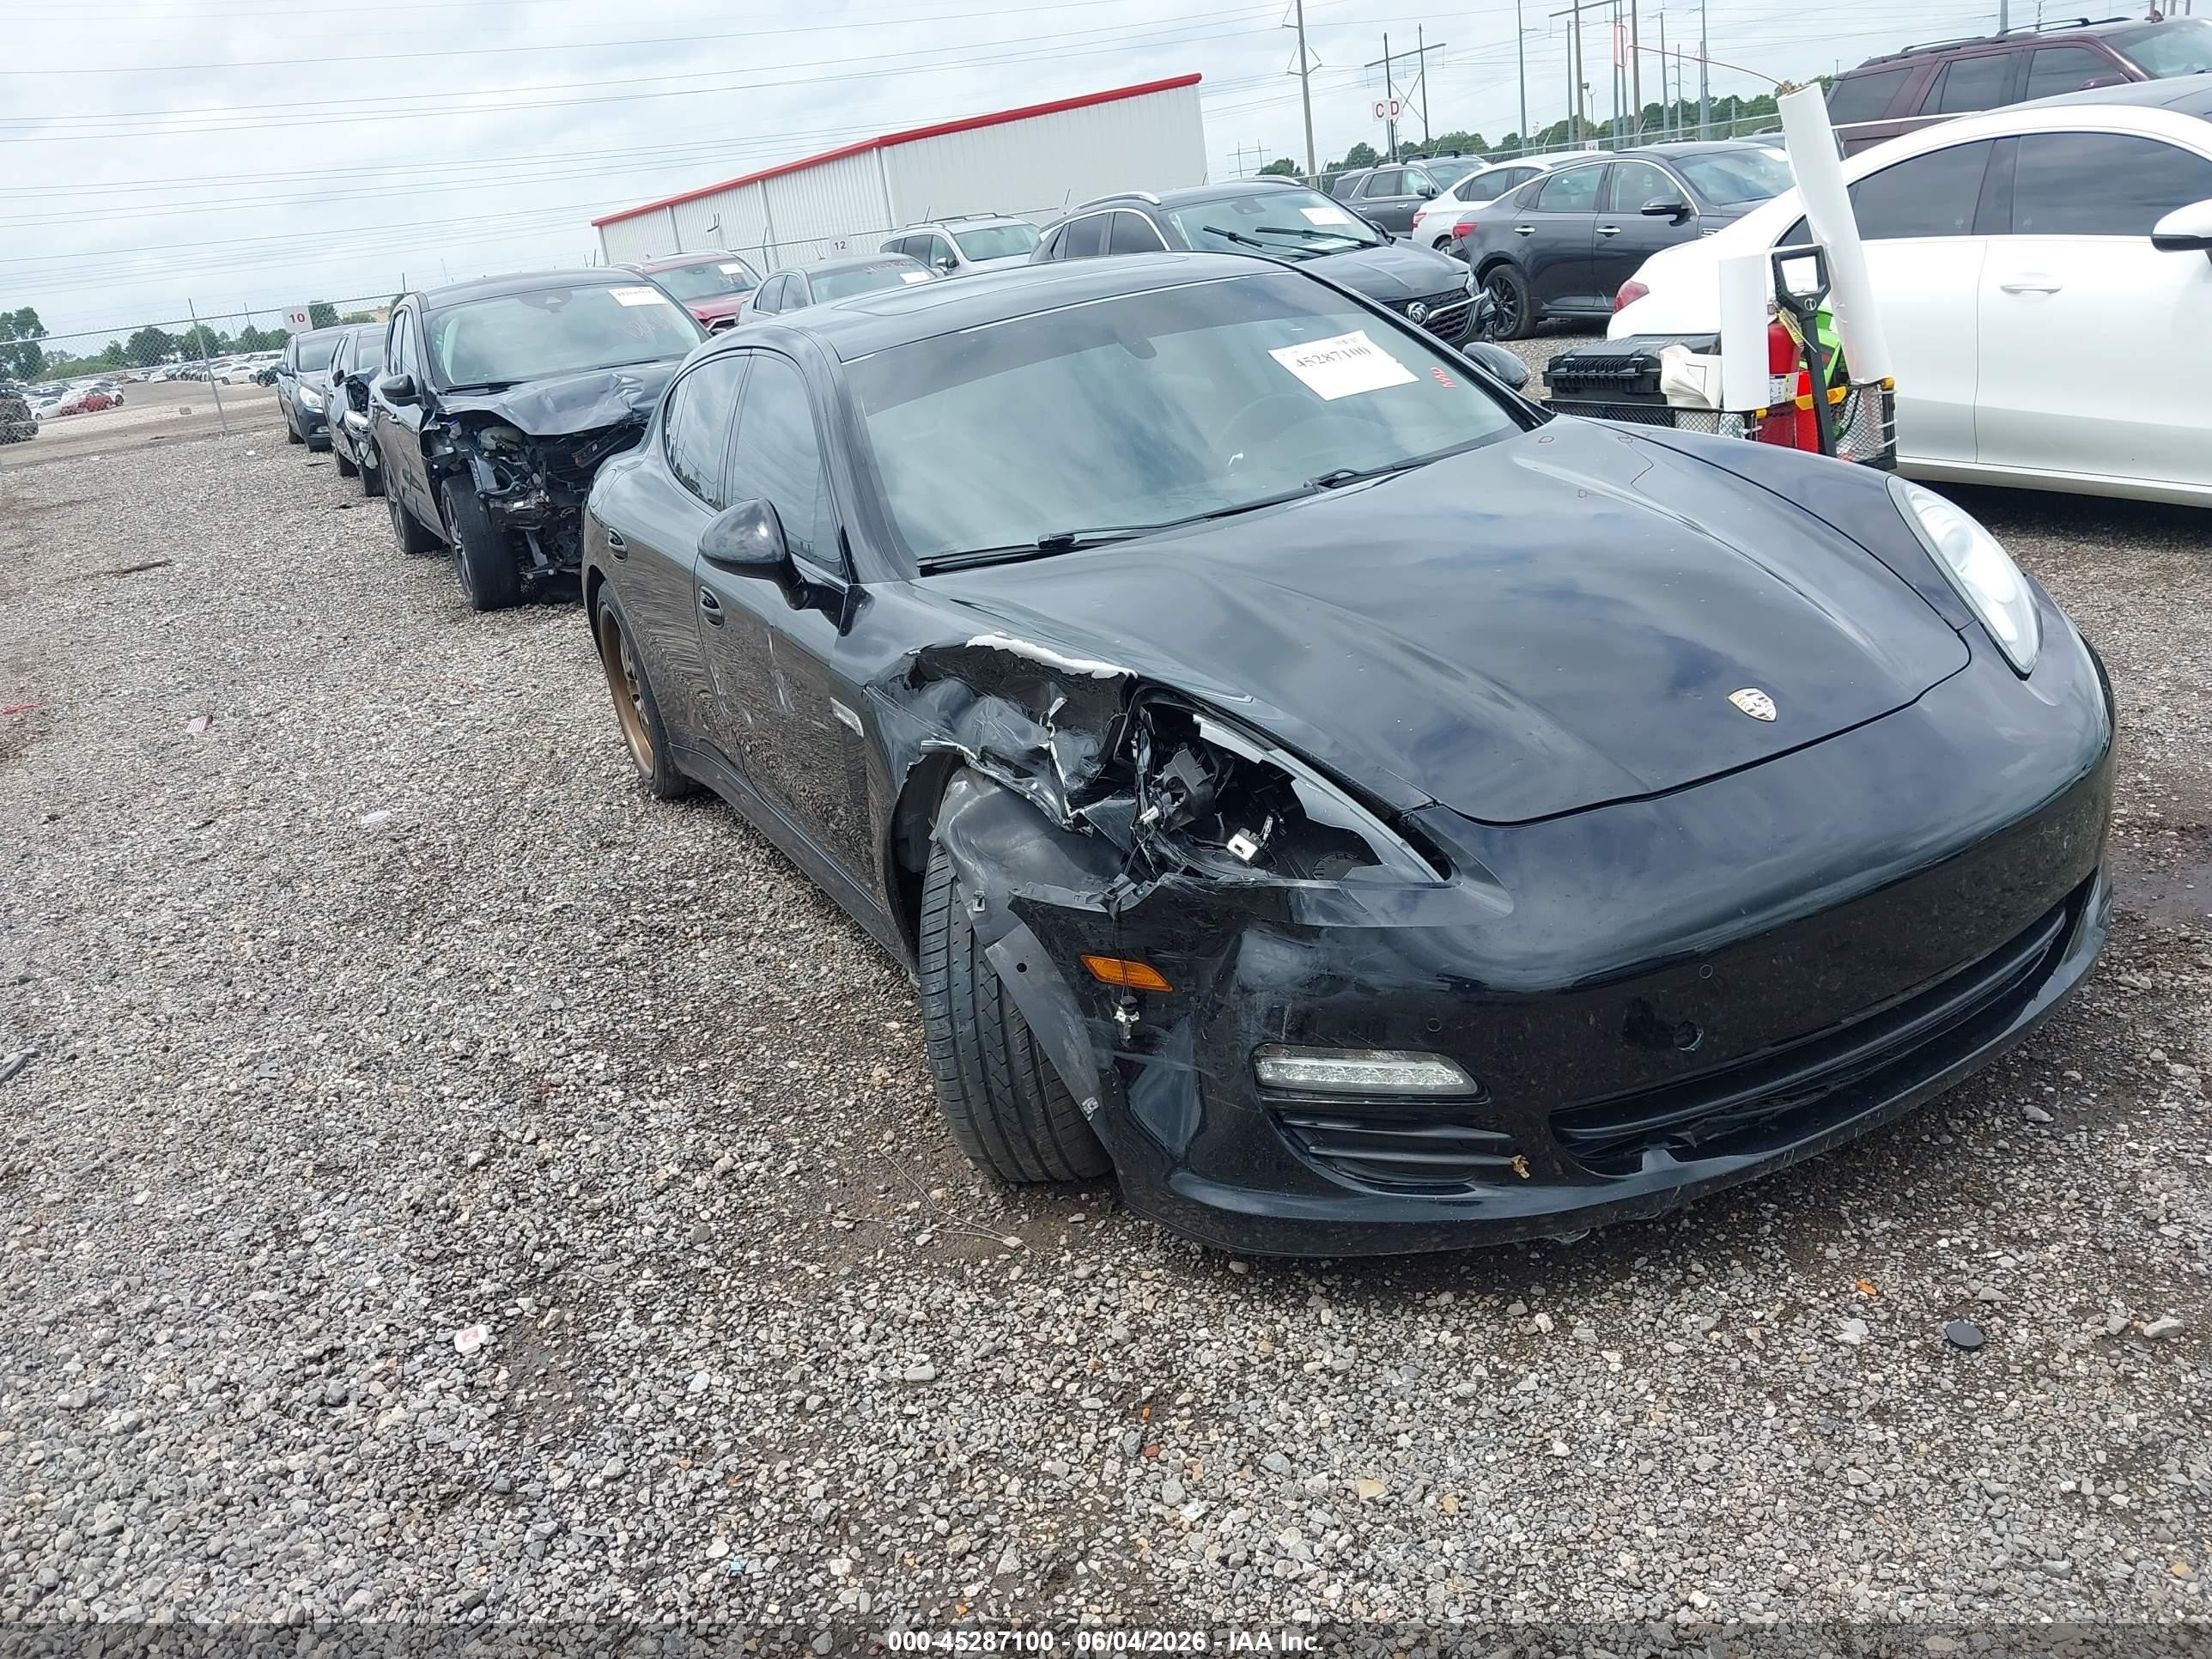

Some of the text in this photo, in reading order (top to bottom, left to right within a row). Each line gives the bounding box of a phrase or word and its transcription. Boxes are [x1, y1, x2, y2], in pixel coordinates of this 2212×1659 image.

[1376, 103, 1384, 118] C
[1390, 100, 1399, 115] D
[835, 240, 847, 251] 12
[289, 313, 306, 324] 10
[1296, 345, 1372, 368] 45287100
